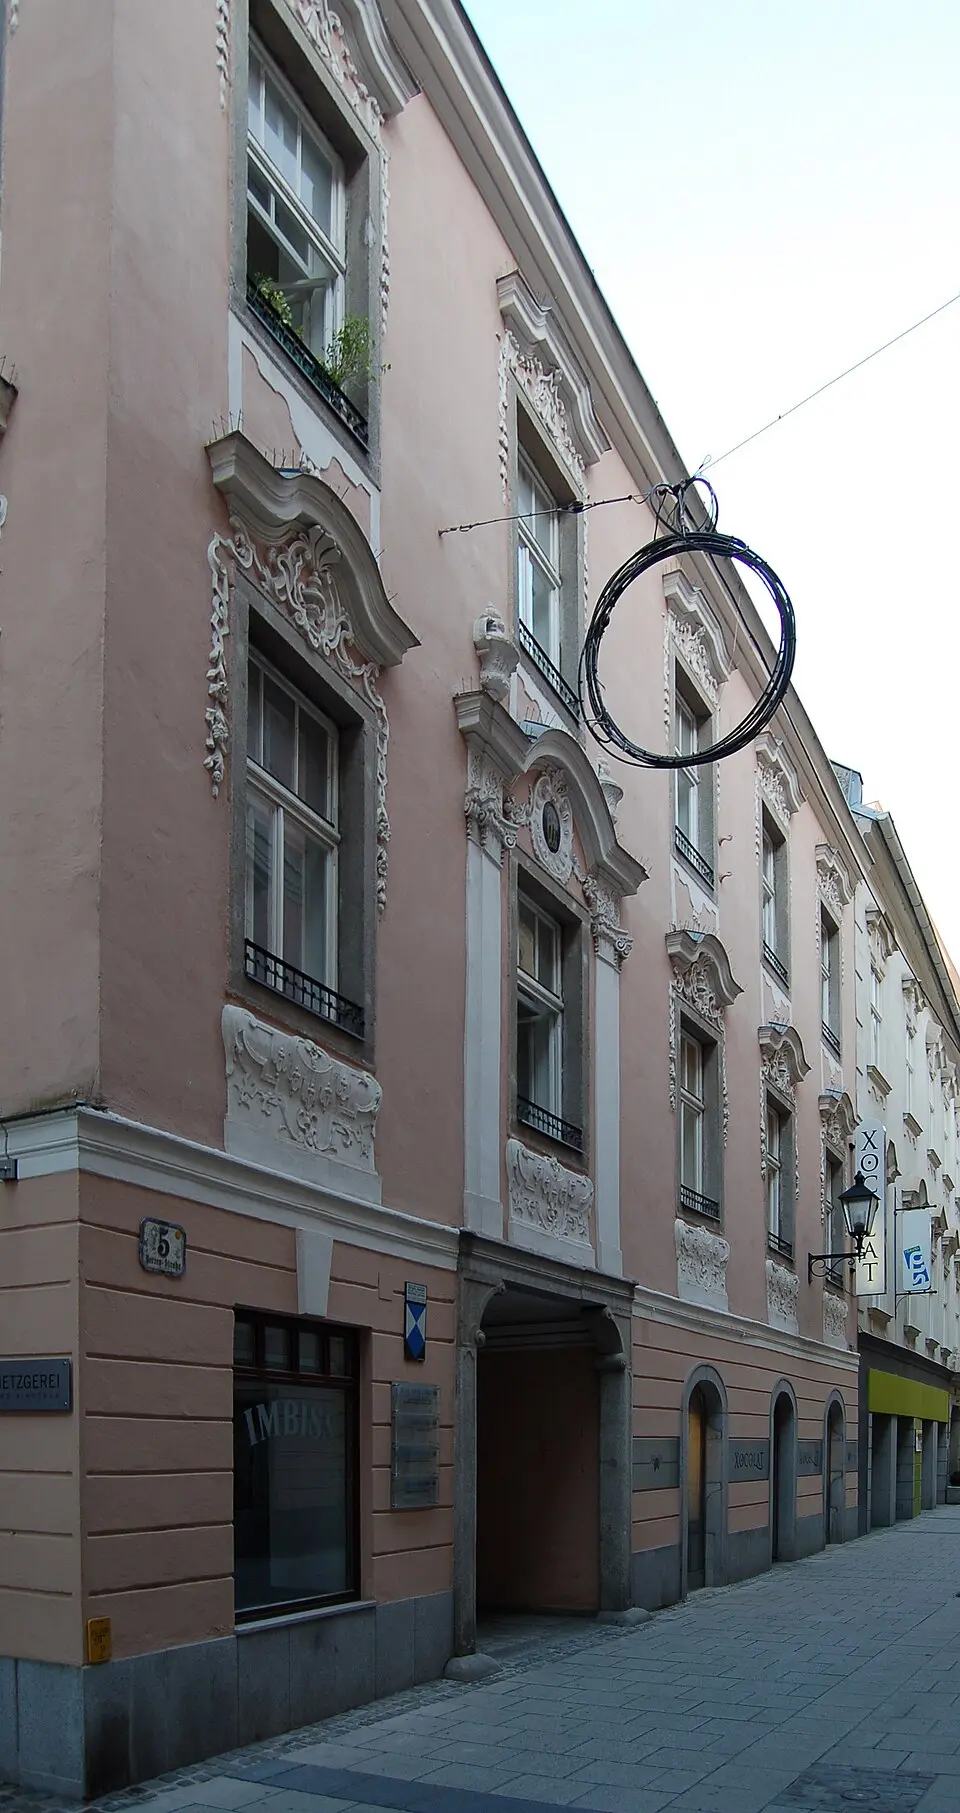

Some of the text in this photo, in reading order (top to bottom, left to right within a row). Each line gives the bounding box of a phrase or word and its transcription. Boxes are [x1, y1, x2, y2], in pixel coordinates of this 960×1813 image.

[861, 1129, 879, 1282] XOCAT
[157, 1227, 170, 1258] 5
[0, 1373, 60, 1390] ETZGEREI
